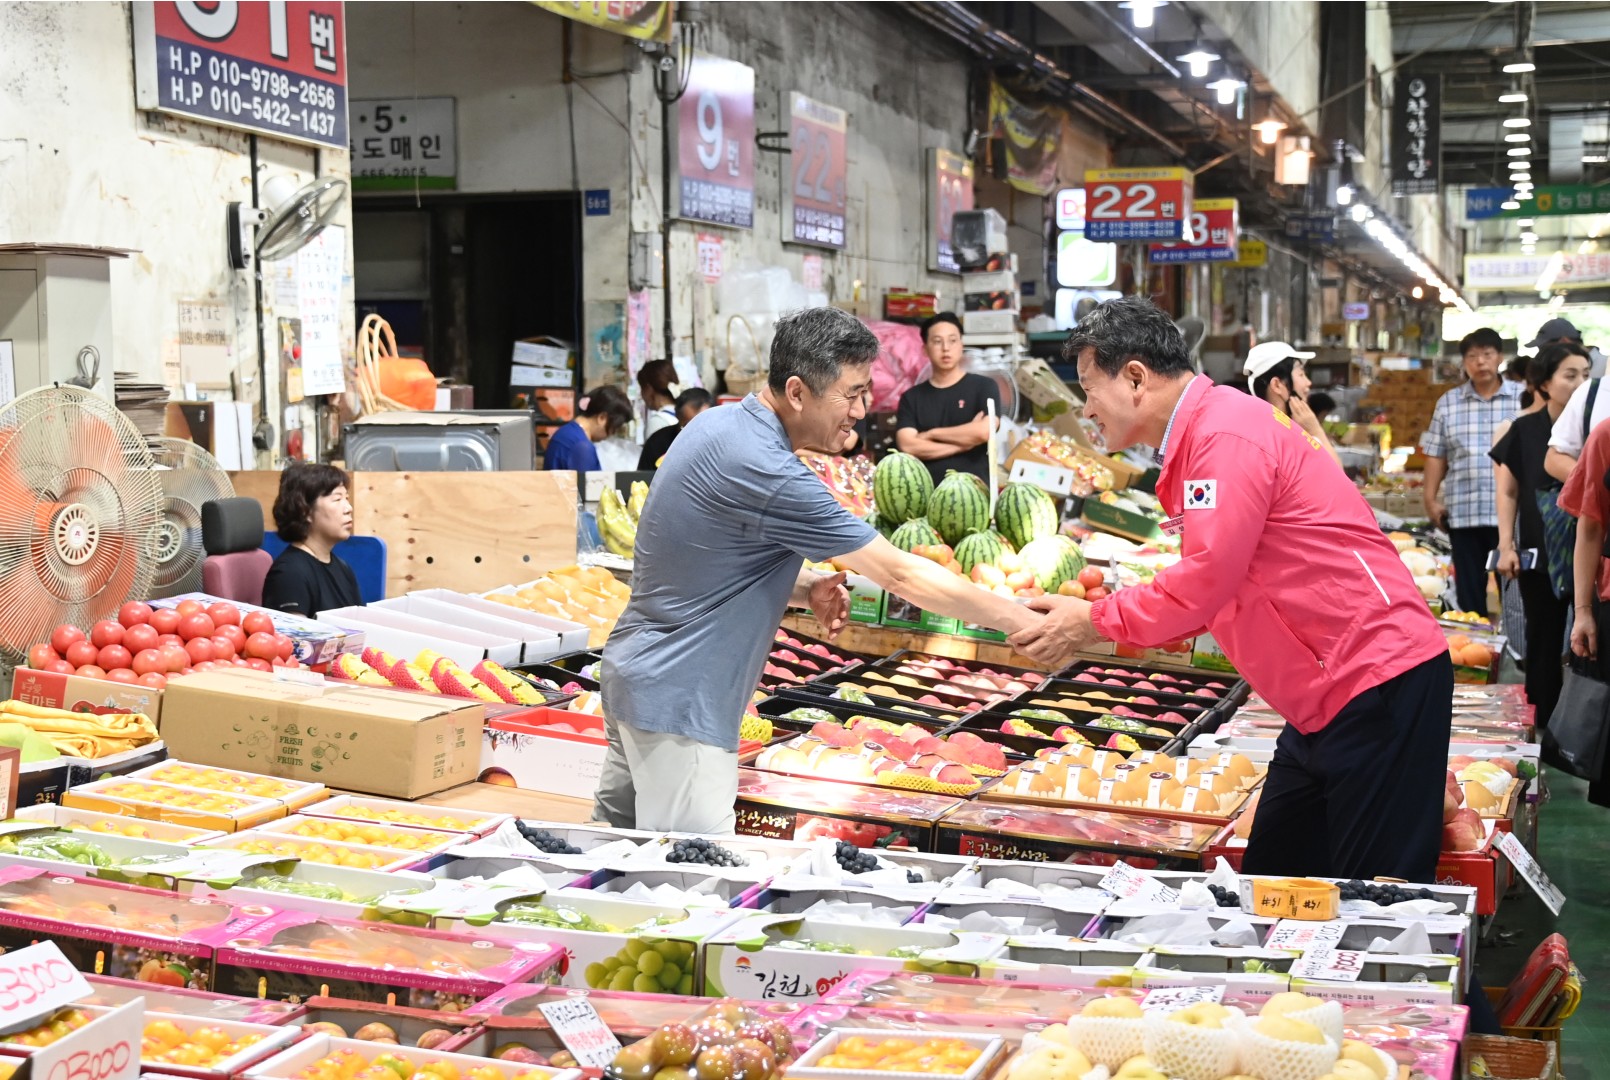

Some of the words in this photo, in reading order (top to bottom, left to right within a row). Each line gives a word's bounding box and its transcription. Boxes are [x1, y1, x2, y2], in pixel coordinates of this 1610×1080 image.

[169, 45, 202, 76] H.P
[208, 55, 335, 111] 010-9798-2656
[171, 75, 203, 106] H.P
[210, 85, 336, 137] 010-5422-1437
[279, 735, 303, 746] FRESH
[282, 746, 300, 755] GIFT
[277, 755, 303, 766] FRUITS
[755, 969, 801, 999] 김천
